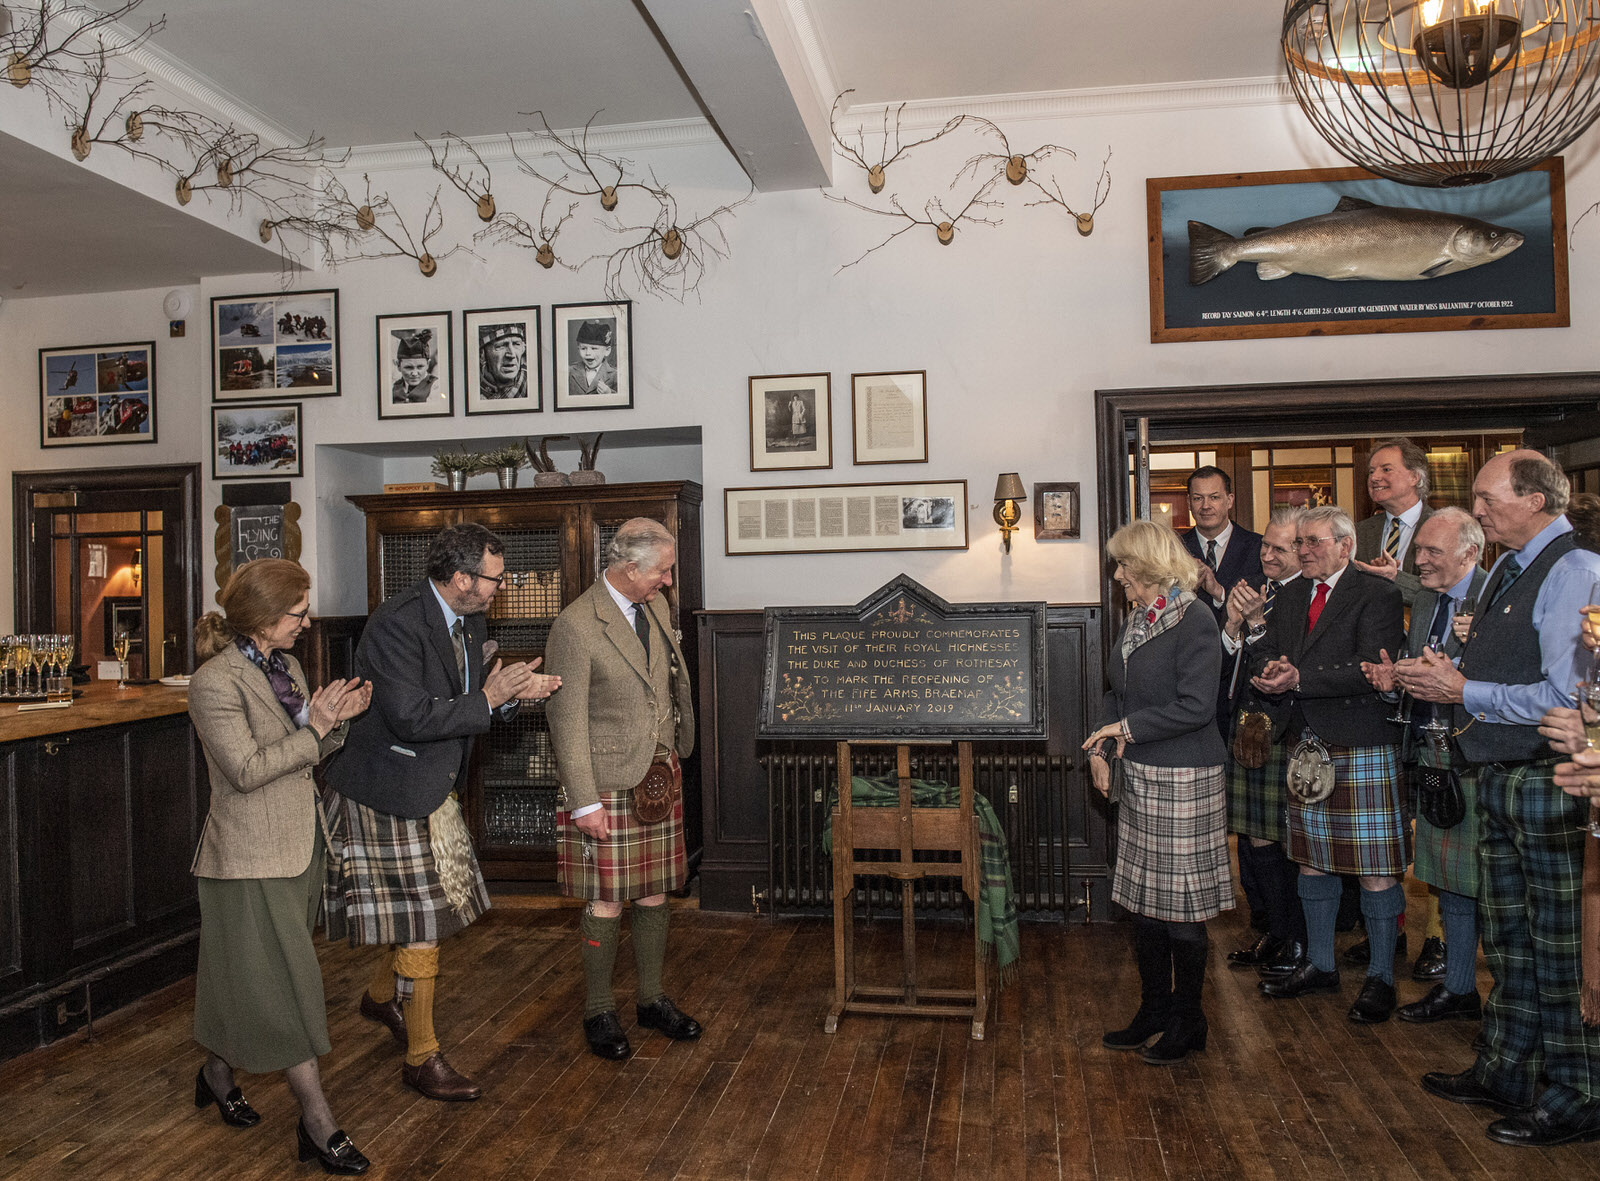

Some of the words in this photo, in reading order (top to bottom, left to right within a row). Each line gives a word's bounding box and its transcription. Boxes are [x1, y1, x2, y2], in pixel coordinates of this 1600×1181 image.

[1202, 312, 1221, 320] RECORD
[1222, 311, 1232, 319] TAY
[1233, 310, 1254, 318] SALMON
[1270, 309, 1291, 317] LENGTH
[1334, 306, 1357, 314] CAUGHT
[1358, 305, 1366, 313] ON
[1400, 303, 1418, 311] WATER
[1419, 303, 1426, 311] BY
[1426, 303, 1438, 311] MISS
[1439, 301, 1469, 310] BALLANTINE
[1477, 300, 1500, 308] OCTOBER
[262, 515, 280, 526] THE
[236, 516, 278, 552] FLYING
[793, 630, 817, 640] THIS
[822, 630, 865, 641] PLAQUE
[871, 630, 920, 639] PROUDLY
[926, 629, 1020, 639] COMMEMORATES
[787, 645, 808, 655] THE
[812, 644, 838, 654] VISIT
[844, 644, 859, 653] OF
[865, 643, 897, 653] THEIR
[904, 643, 941, 652] ROYAL
[788, 660, 809, 669] THE
[813, 659, 840, 669] DUKE
[847, 659, 868, 668] AND
[873, 659, 926, 668] DUCHESS
[933, 659, 949, 668] OF
[956, 658, 1019, 668] ROTHESAY
[813, 675, 830, 684] TO
[836, 675, 868, 684] MARK
[873, 675, 895, 684] THE
[902, 674, 970, 684] REOPENING
[977, 674, 994, 683] OF
[821, 689, 845, 698] THE
[852, 688, 878, 698] FIFE
[925, 688, 983, 698] BRAEMAR
[866, 702, 920, 713] JANUARY
[927, 703, 954, 713] 2019
